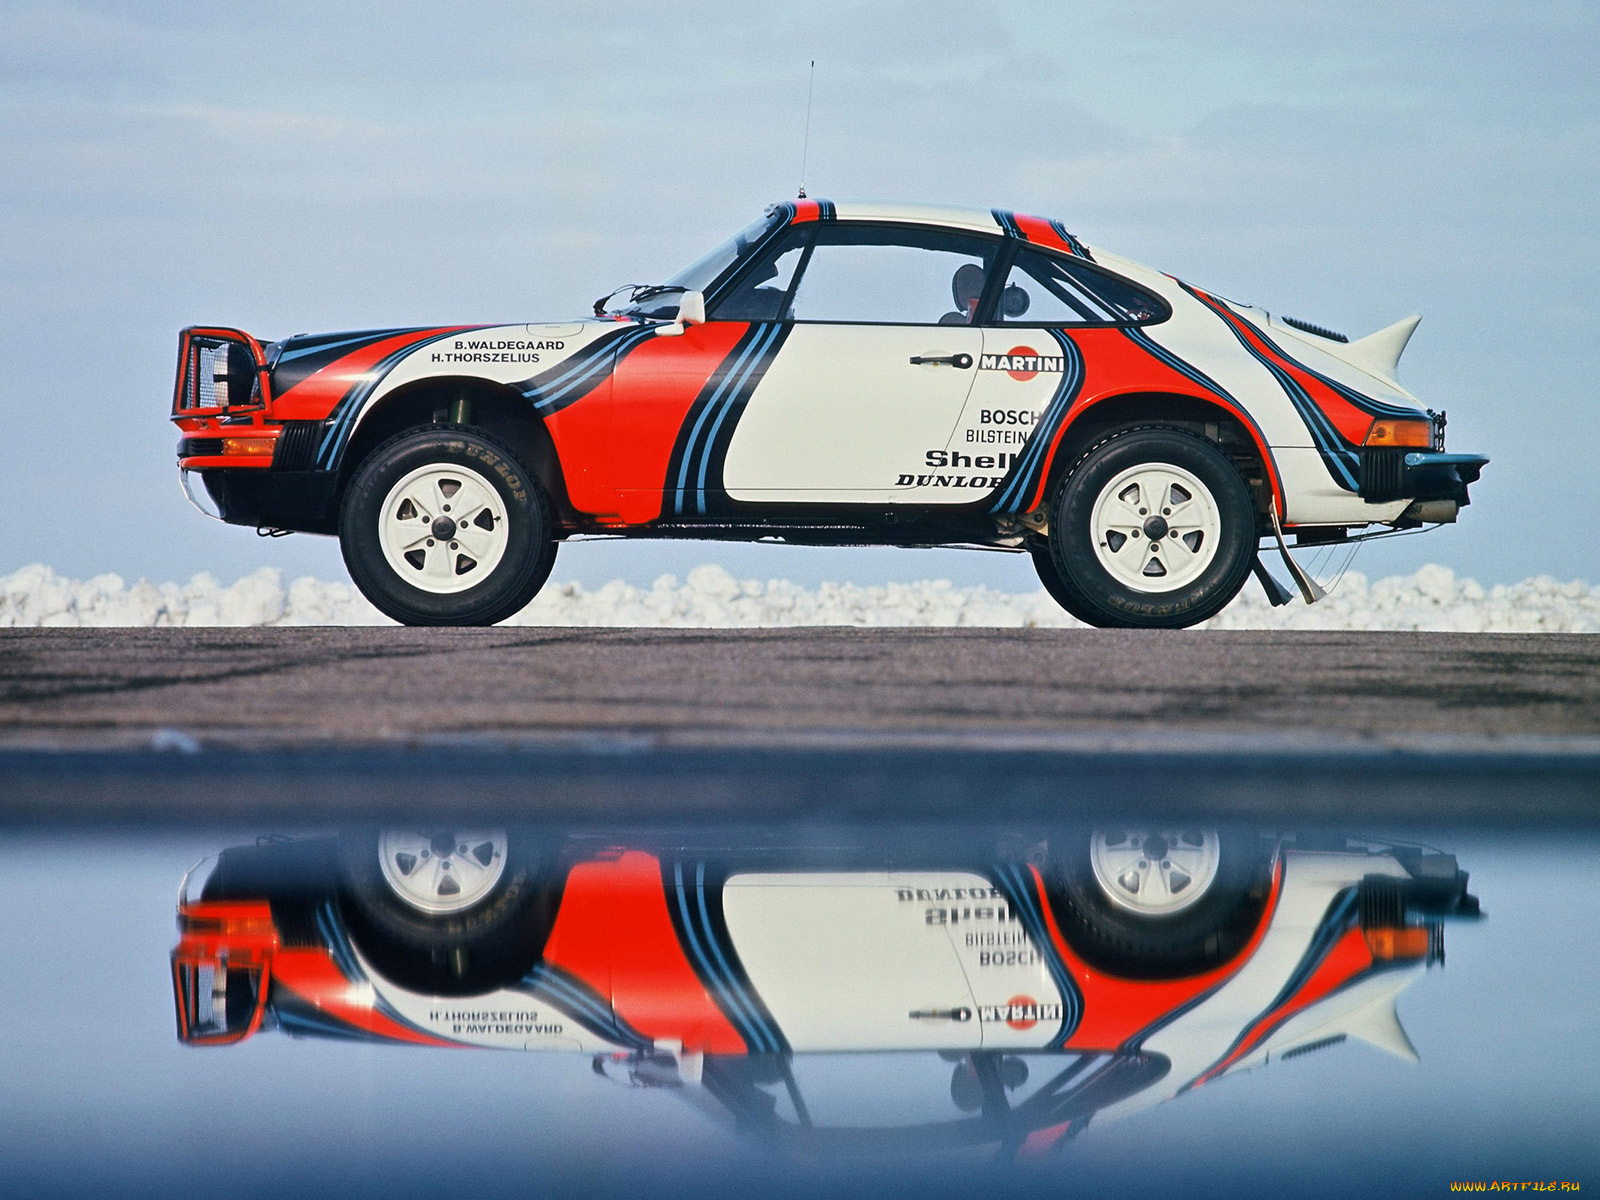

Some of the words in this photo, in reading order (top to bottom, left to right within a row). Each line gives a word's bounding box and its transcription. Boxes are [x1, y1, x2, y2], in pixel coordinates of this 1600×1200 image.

[455, 341, 564, 350] B.WALDEGAARD
[431, 353, 539, 363] H.THORSZELIUS
[981, 355, 1064, 372] MARTINI
[980, 409, 1042, 425] BOSCH
[966, 429, 1028, 444] BILSTEIN
[925, 450, 1017, 469] Shell
[895, 474, 1004, 489] DUNLOP
